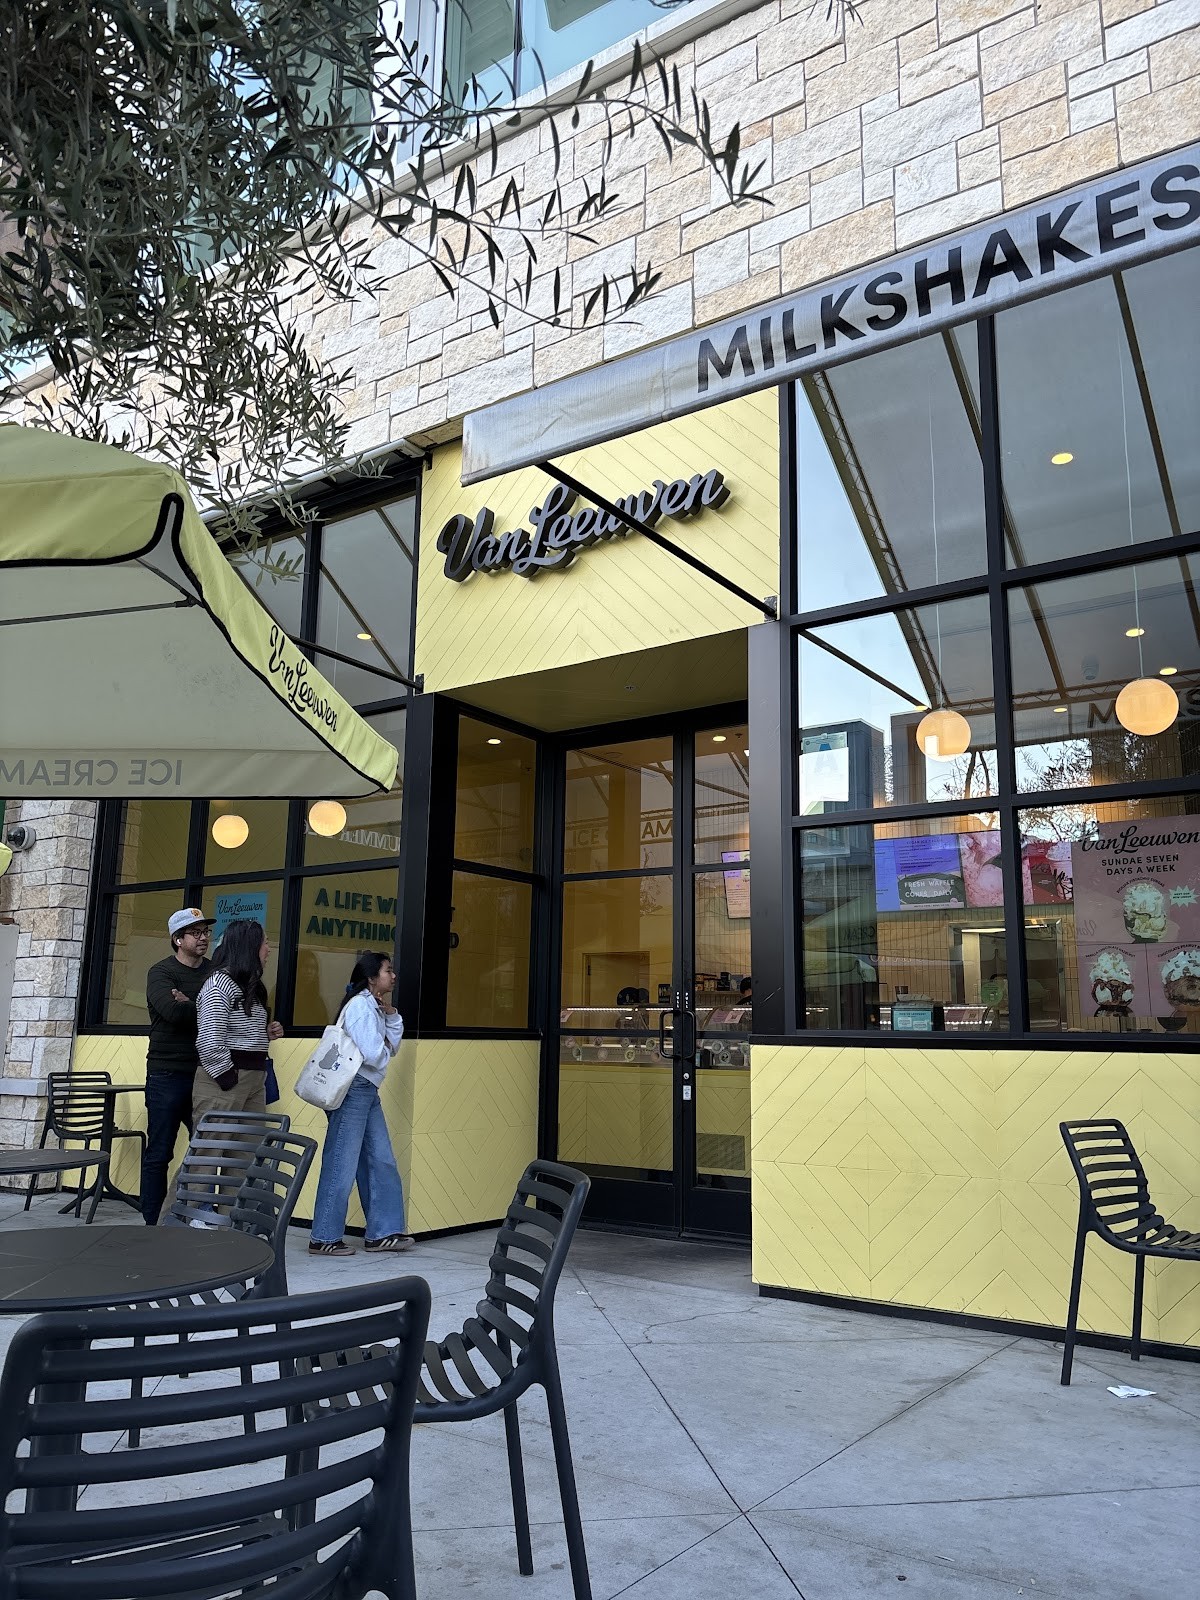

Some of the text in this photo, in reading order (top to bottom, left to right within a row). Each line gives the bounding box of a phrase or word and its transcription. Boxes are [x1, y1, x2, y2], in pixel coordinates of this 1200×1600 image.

[697, 164, 1200, 393] MILKSHAKES
[436, 468, 731, 582] Van Leeuwen
[1114, 825, 1200, 854] Leeuwen
[1101, 854, 1179, 866] SUNDAE SEVEN
[1106, 864, 1176, 876] DAYS A WEEK
[929, 879, 955, 887] WAFFLE
[218, 898, 264, 916] Van Leeuwen
[314, 887, 330, 907] A
[334, 889, 373, 913] LIFE
